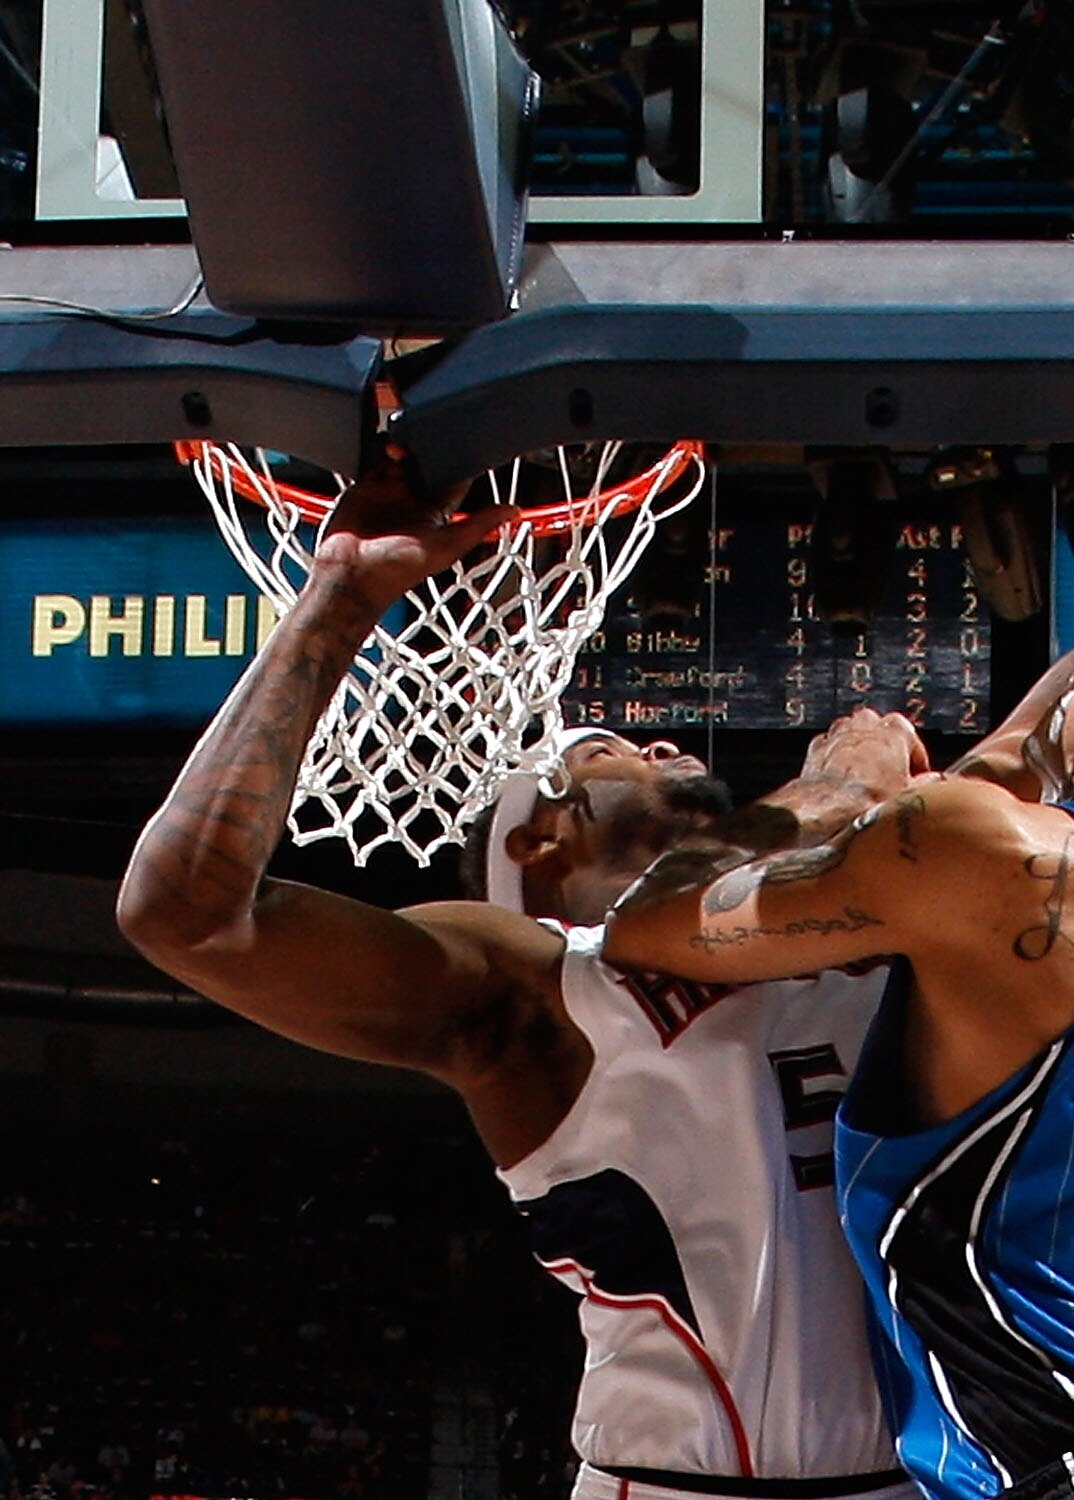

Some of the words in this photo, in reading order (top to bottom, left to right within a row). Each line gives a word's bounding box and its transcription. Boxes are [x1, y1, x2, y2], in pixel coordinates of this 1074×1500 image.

[787, 557, 808, 587] 9
[907, 557, 928, 588] 4
[960, 592, 980, 624] 2
[960, 699, 980, 728] 2
